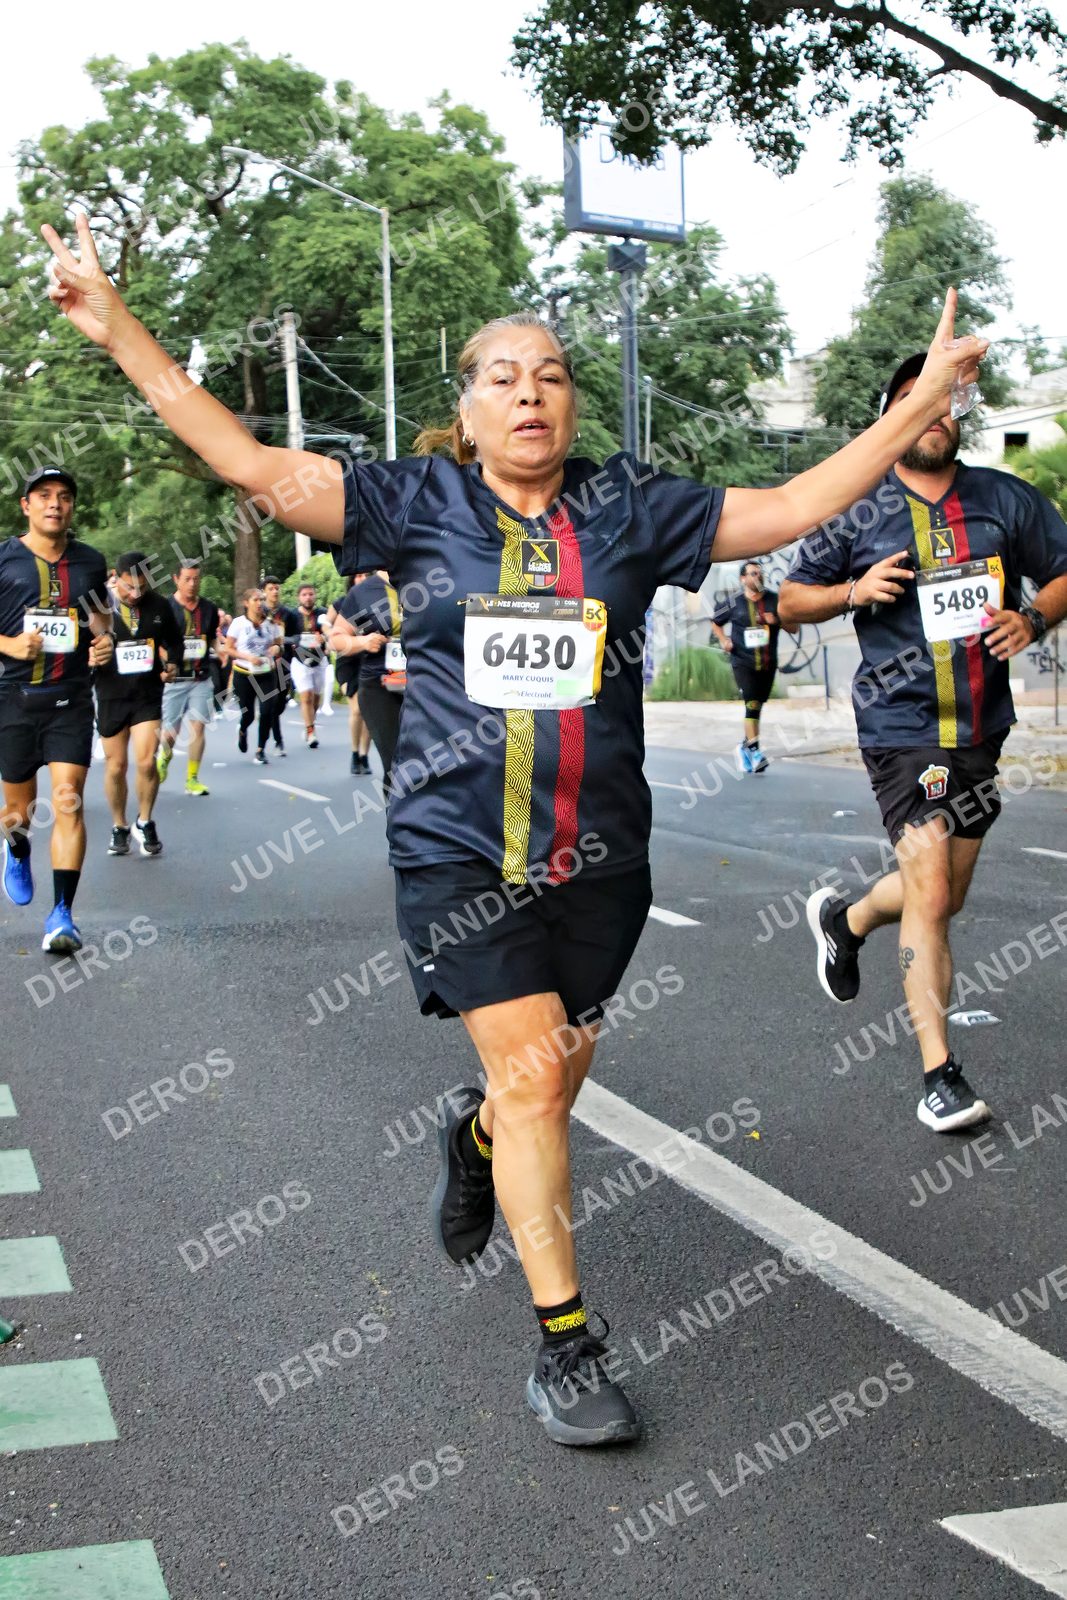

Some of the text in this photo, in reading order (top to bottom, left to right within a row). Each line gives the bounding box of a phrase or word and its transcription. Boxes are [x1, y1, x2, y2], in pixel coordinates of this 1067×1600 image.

[933, 585, 989, 615] 5489
[586, 607, 602, 620] 5K
[122, 649, 148, 661] 4922
[482, 632, 576, 670] 6430
[525, 675, 554, 683] CUQUIS
